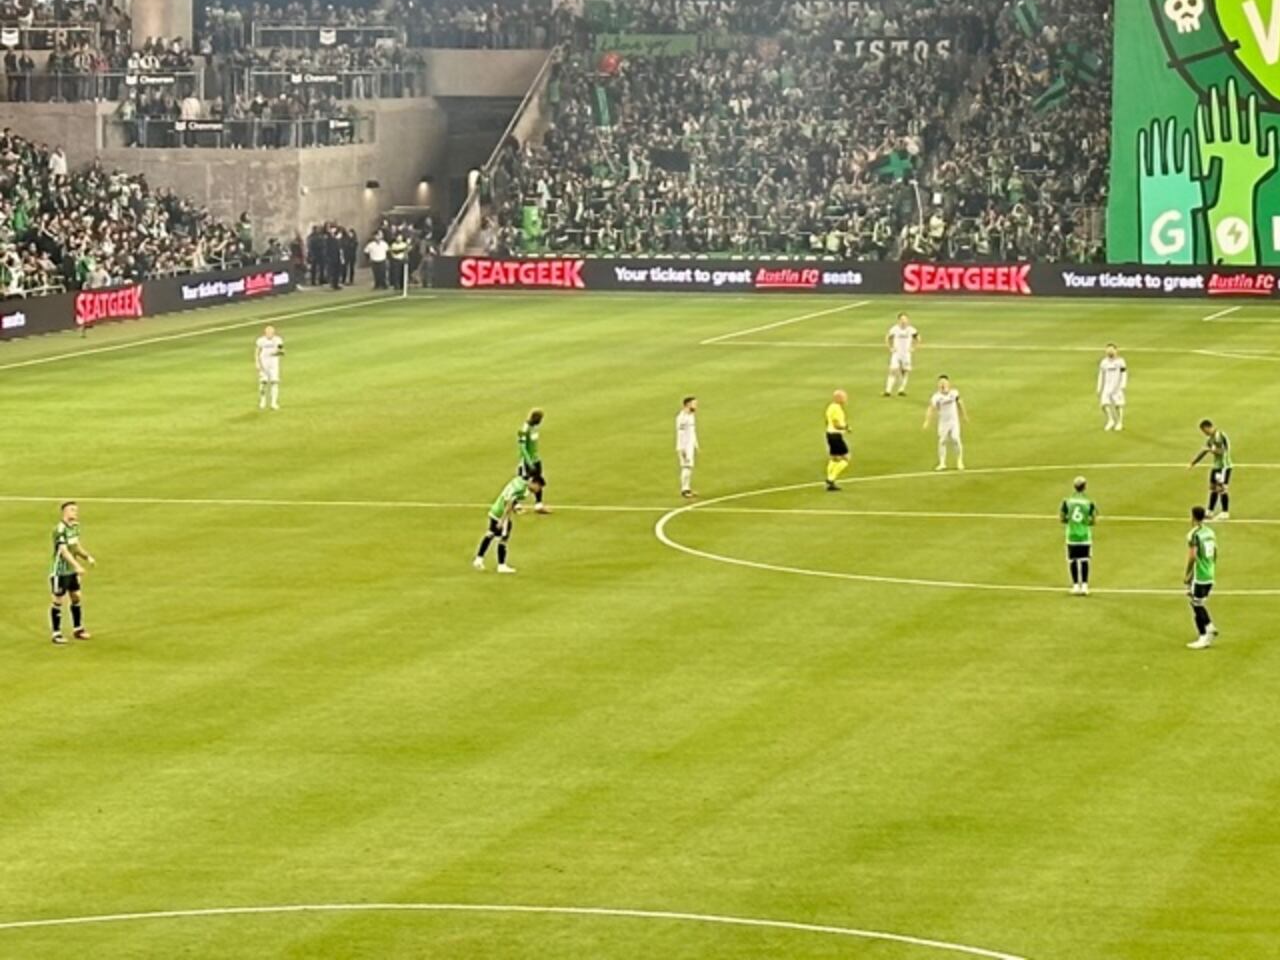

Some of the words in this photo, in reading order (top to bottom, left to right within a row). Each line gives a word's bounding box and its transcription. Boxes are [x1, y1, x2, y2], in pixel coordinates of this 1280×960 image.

[459, 259, 585, 288] SEATGEEK
[614, 266, 648, 281] Your
[650, 266, 692, 282] ticket
[694, 269, 710, 282] to
[712, 269, 752, 286] great
[755, 268, 799, 283] Austin
[801, 268, 819, 283] FC
[822, 270, 862, 285] seats
[903, 263, 1032, 294] SEATGEEK
[1062, 271, 1096, 287] Your
[1099, 272, 1142, 288] ticket
[1144, 274, 1161, 288] to
[1164, 275, 1204, 292] great
[1208, 274, 1253, 289] Austin
[1255, 274, 1275, 289] FC
[75, 285, 143, 325] SEATGEEK
[1071, 506, 1083, 523] 6
